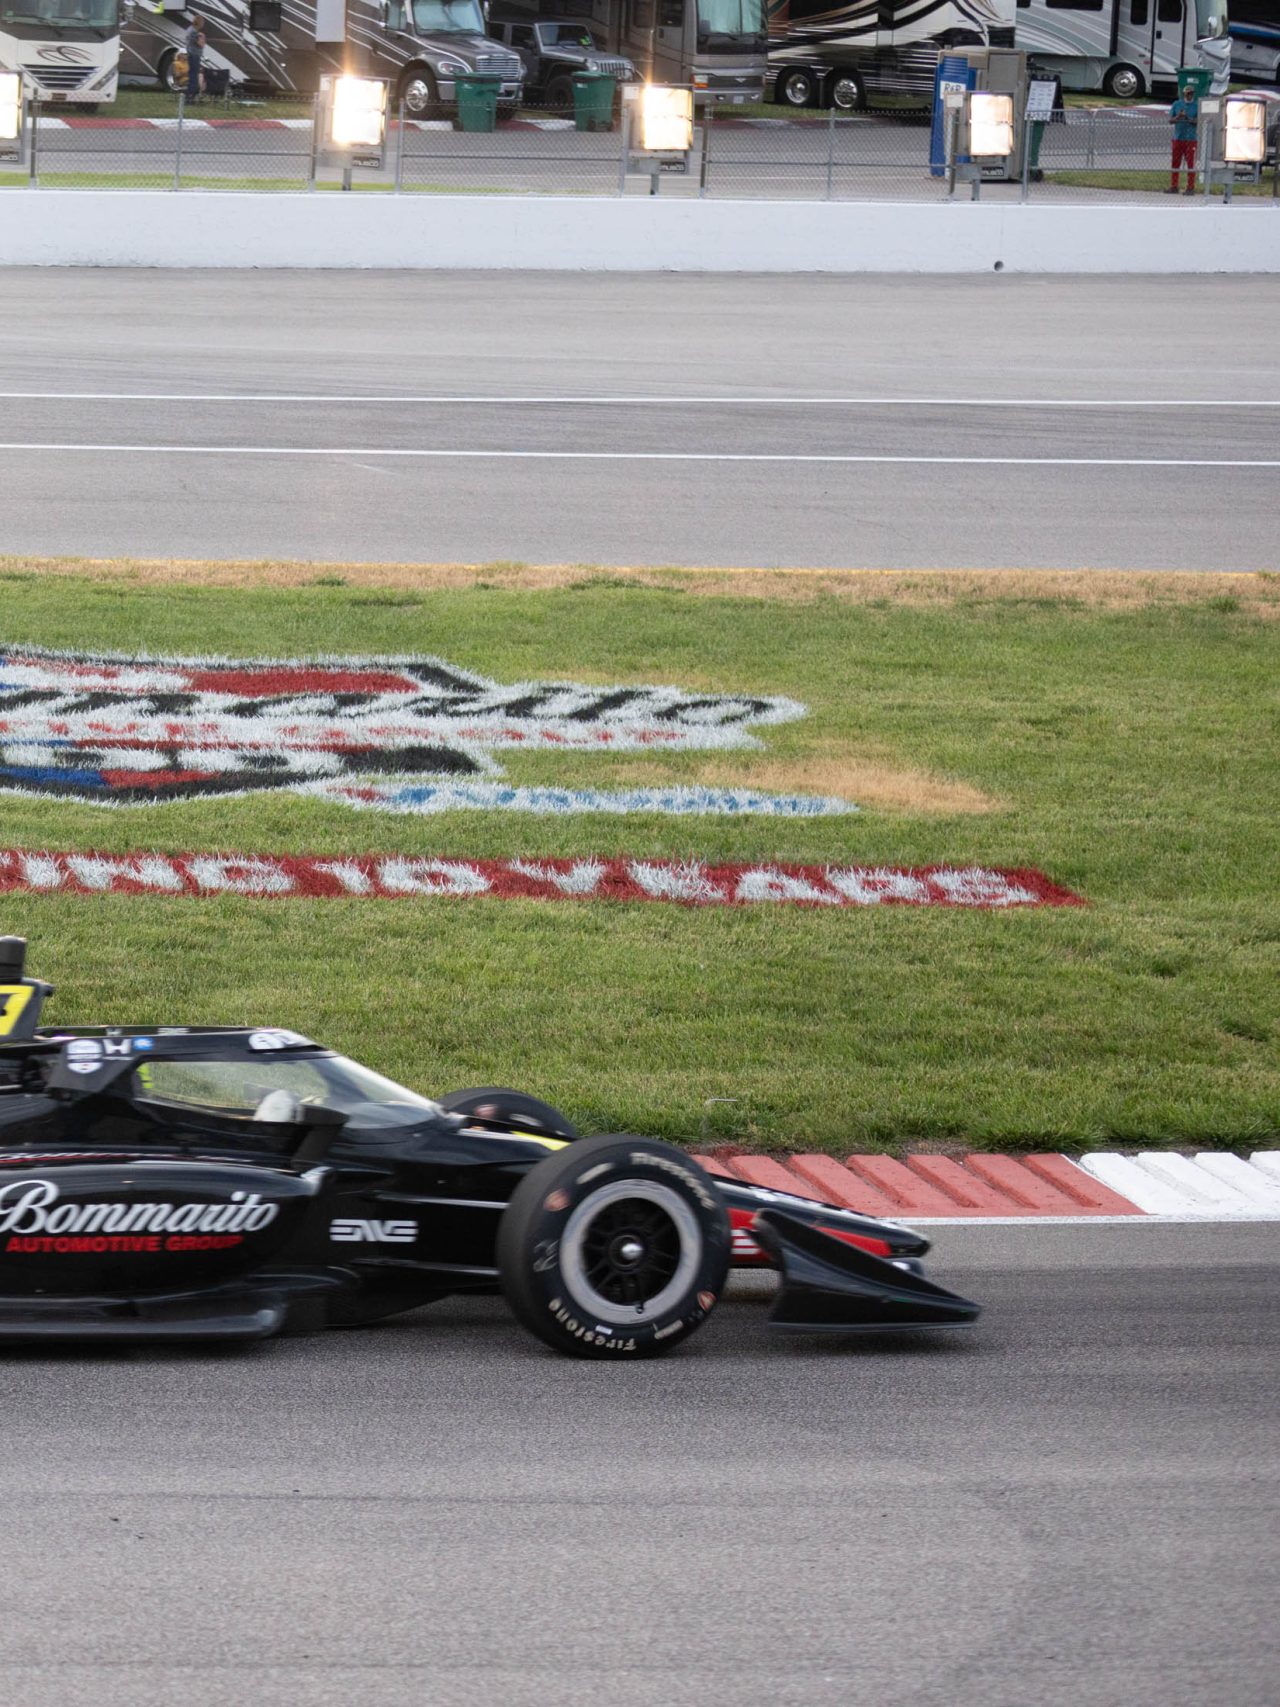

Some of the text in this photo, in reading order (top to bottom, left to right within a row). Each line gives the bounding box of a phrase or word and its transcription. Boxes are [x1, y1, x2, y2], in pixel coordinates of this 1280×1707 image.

[313, 855, 493, 896] 10
[509, 856, 1038, 906] YEARS
[6, 1235, 245, 1253] AUTOMOTIVE GROUP
[548, 1297, 638, 1351] Firestone
